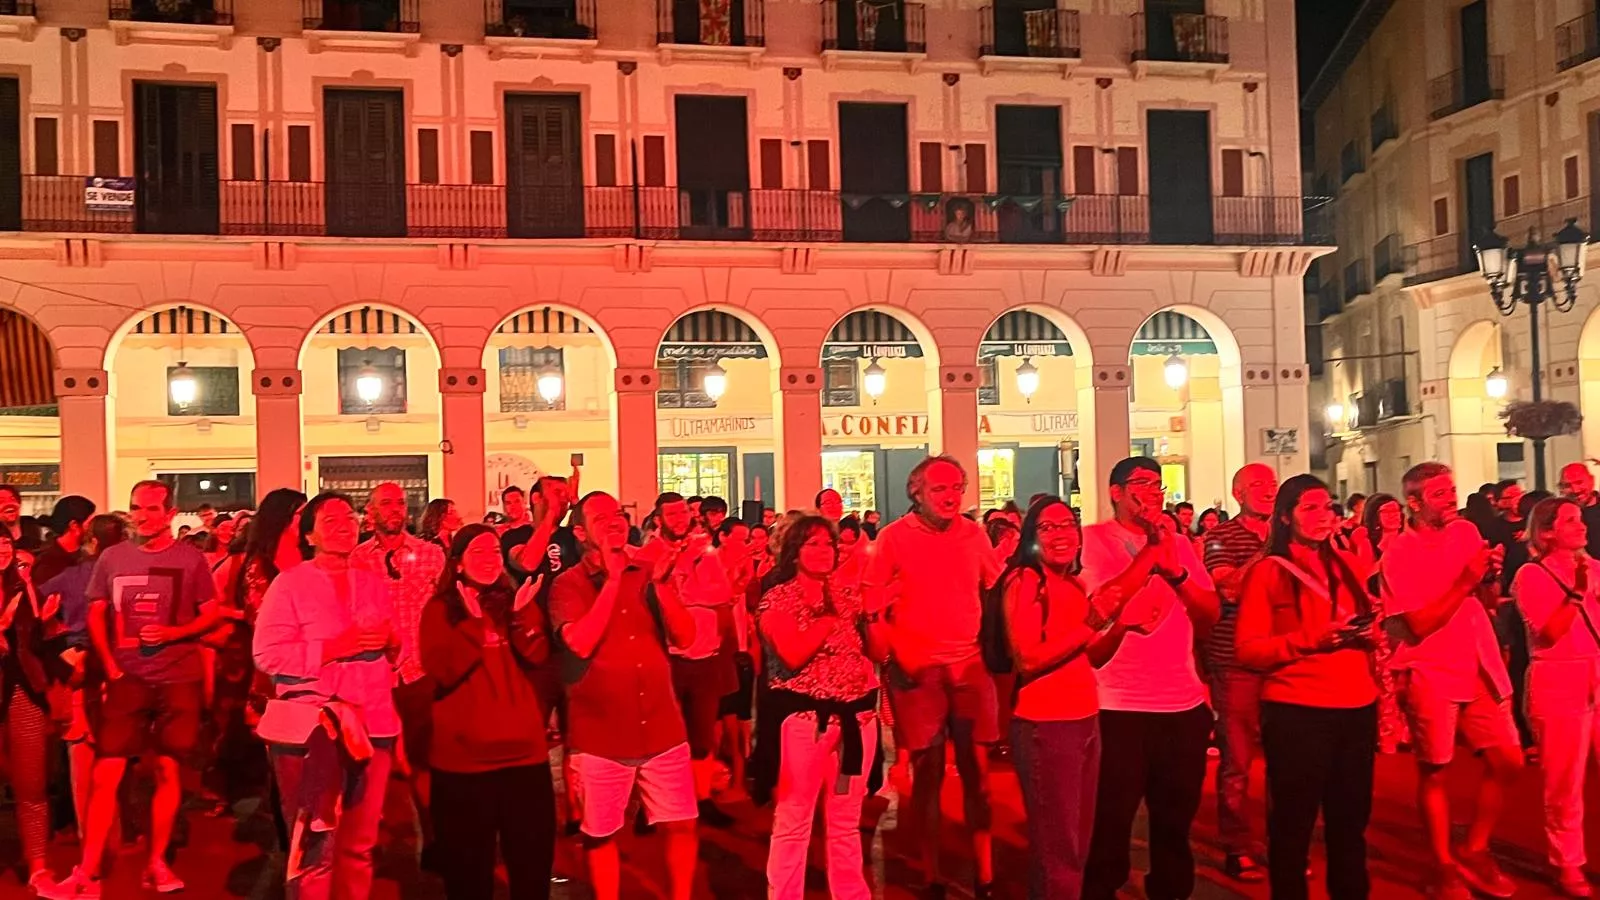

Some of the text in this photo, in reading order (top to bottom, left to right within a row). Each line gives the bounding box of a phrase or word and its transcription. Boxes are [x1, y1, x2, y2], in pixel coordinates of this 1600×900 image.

[87, 191, 134, 202] SE VENDE
[863, 344, 873, 357] LA
[873, 344, 907, 357] CONFIANZA
[1014, 343, 1023, 356] LA
[1023, 343, 1056, 355] CONFIANZA
[672, 417, 756, 438] ULTRAMARINOS
